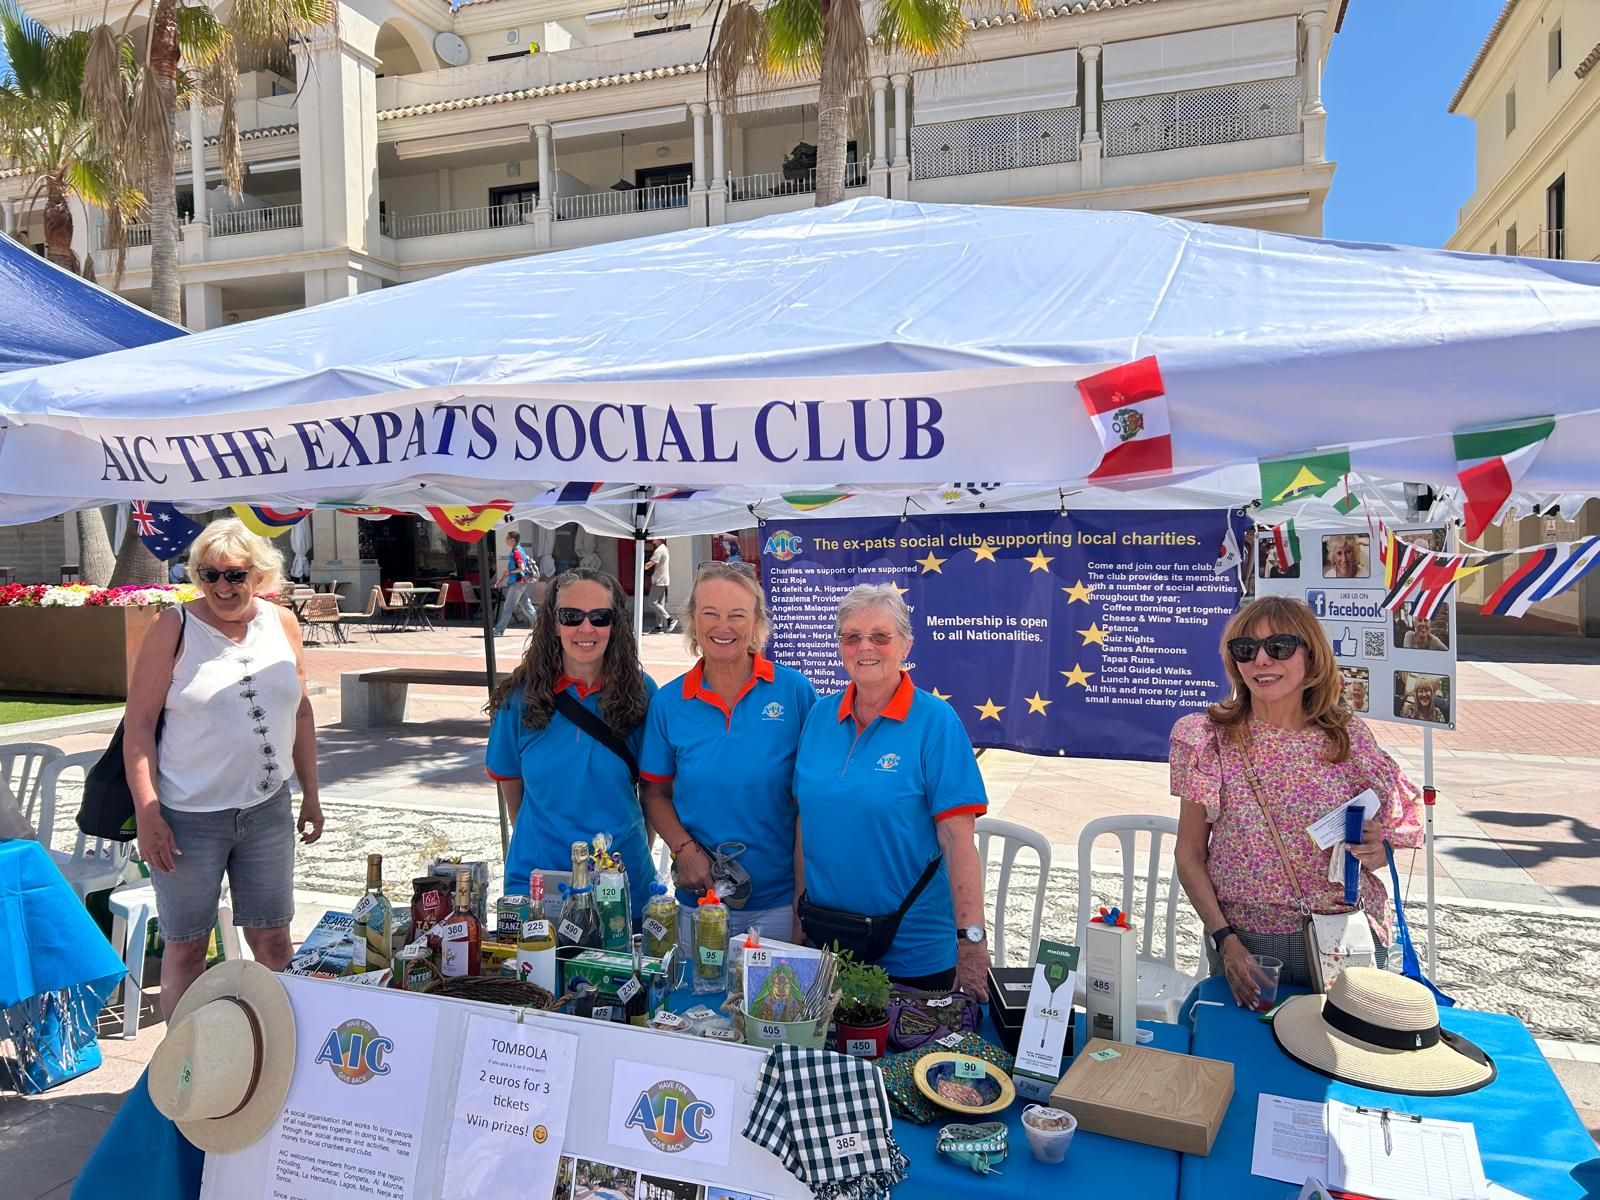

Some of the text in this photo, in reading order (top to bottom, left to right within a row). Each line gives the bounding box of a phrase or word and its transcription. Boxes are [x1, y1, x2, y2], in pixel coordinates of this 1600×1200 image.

[99, 396, 945, 484] AIC THE EXPATS SOCIAL CLUB
[763, 536, 802, 554] AIC
[813, 531, 1201, 552] The ex-pats social club supporting local charities.
[878, 565, 917, 574] supported
[1087, 562, 1114, 570] Come
[1116, 562, 1133, 570] and
[1135, 562, 1153, 571] join
[790, 577, 806, 585] Roja
[1088, 572, 1105, 580] The
[1106, 572, 1126, 580] club
[1128, 573, 1169, 582] provides
[1186, 574, 1230, 582] members
[1087, 582, 1106, 590] with
[1117, 583, 1151, 591] number
[1154, 583, 1163, 591] of
[1166, 584, 1194, 592] social
[1196, 584, 1238, 593] activities
[772, 595, 811, 603] Grazalema
[1087, 593, 1181, 604] throughout the year;
[772, 605, 802, 613] Angelos
[1102, 604, 1233, 616] Coffee morning get together
[1329, 601, 1382, 618] facebook
[927, 616, 1047, 628] Membership is open
[1102, 614, 1208, 625] Cheese & Wine Tasting
[773, 622, 834, 630] APAT Almunecar
[1102, 624, 1139, 633] Petanca
[812, 632, 832, 640] Nerja
[932, 630, 1043, 642] to all Nationalities.
[1102, 634, 1155, 645] Quiz Nights
[774, 650, 794, 658] Taller
[807, 650, 837, 658] Amistad
[1102, 644, 1187, 655] Games Afternoons
[1102, 654, 1155, 664] Tapas Runs
[814, 668, 835, 676] Niños
[1101, 665, 1192, 676] Local Guided Walks
[1101, 675, 1219, 688] Lunch and Dinner events.
[1100, 685, 1117, 694] this
[1119, 686, 1136, 694] and
[1165, 688, 1179, 696] for
[1180, 688, 1198, 697] just
[1085, 696, 1109, 704] small
[1112, 697, 1143, 705] annual
[1145, 698, 1176, 708] charity
[602, 888, 616, 896] 120
[357, 899, 370, 913] 320
[448, 925, 463, 935] 360
[527, 922, 544, 931] 225
[565, 923, 578, 935] 490
[648, 921, 663, 933] 500
[706, 951, 716, 960] 95
[752, 952, 767, 961] 415
[622, 981, 636, 996] 230
[1093, 980, 1110, 991] 485
[594, 1008, 608, 1017] 475
[660, 1013, 677, 1022] 350
[1040, 1007, 1059, 1017] 445
[346, 1020, 372, 1031] HAVE FUN
[763, 1026, 780, 1035] 405
[491, 1039, 548, 1061] TOMBOLA
[853, 1042, 870, 1050] 450
[315, 1028, 394, 1076] AIC
[964, 1063, 976, 1072] 90
[338, 1072, 366, 1084] GIVE BACK
[479, 1070, 550, 1094] 2 euros for 3
[657, 1081, 688, 1095] HAVE FUN
[493, 1095, 530, 1112] tickets
[625, 1090, 715, 1143] AIC
[290, 1110, 306, 1118] social
[342, 1119, 352, 1127] that
[355, 1122, 370, 1130] works
[380, 1127, 393, 1136] bring
[394, 1130, 412, 1139] people
[466, 1113, 529, 1137] Win prizes!
[651, 1137, 685, 1152] GIVE BACK
[836, 1136, 856, 1150] 385
[290, 1153, 315, 1163] welcomes
[317, 1158, 342, 1169] members
[344, 1163, 357, 1171] from
[358, 1167, 376, 1176] across
[378, 1170, 386, 1178] the
